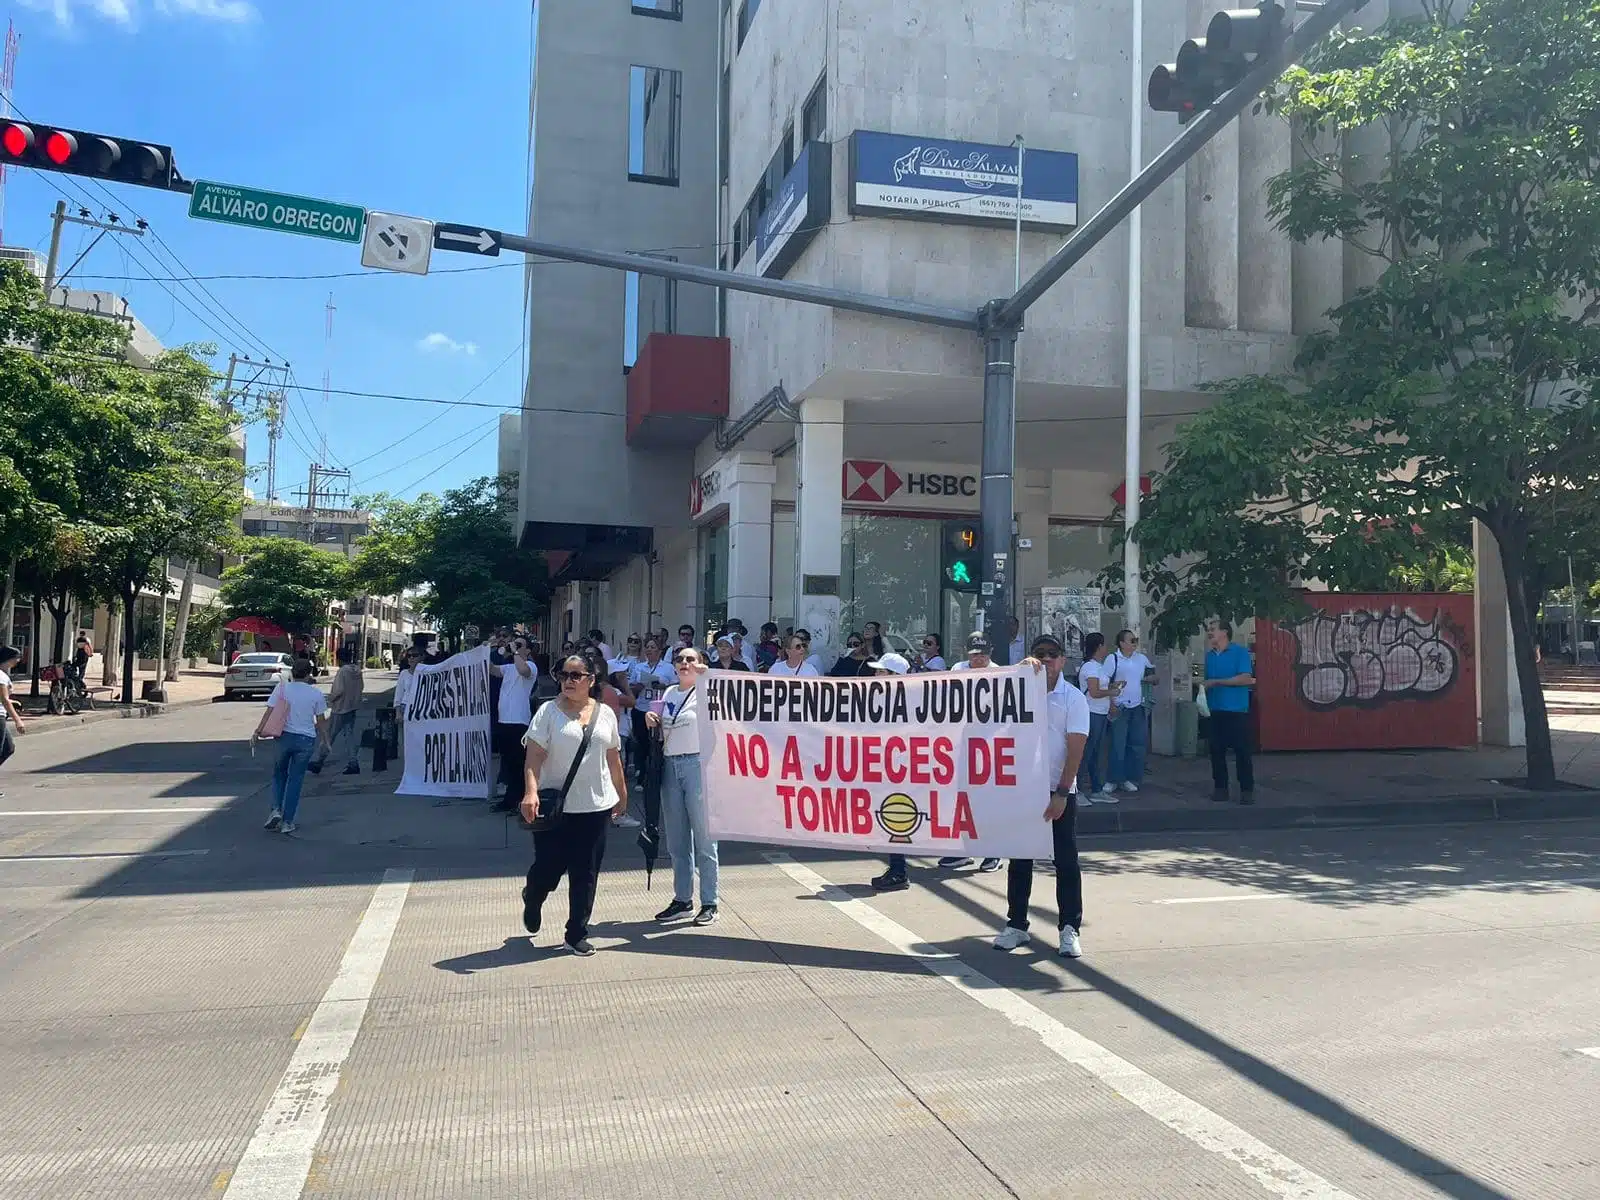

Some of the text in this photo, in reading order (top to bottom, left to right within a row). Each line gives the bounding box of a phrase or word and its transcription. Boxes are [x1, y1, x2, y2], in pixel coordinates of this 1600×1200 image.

[205, 186, 242, 197] AVENIDA
[198, 194, 357, 236] ALVARO OBREGON
[908, 473, 976, 496] HSBC
[962, 530, 973, 548] 4
[707, 677, 1033, 724] #INDEPENDENCIA JUDICIAL
[424, 733, 446, 783] POR
[449, 732, 461, 783] LA
[726, 733, 1017, 786] NO A JUECES DE
